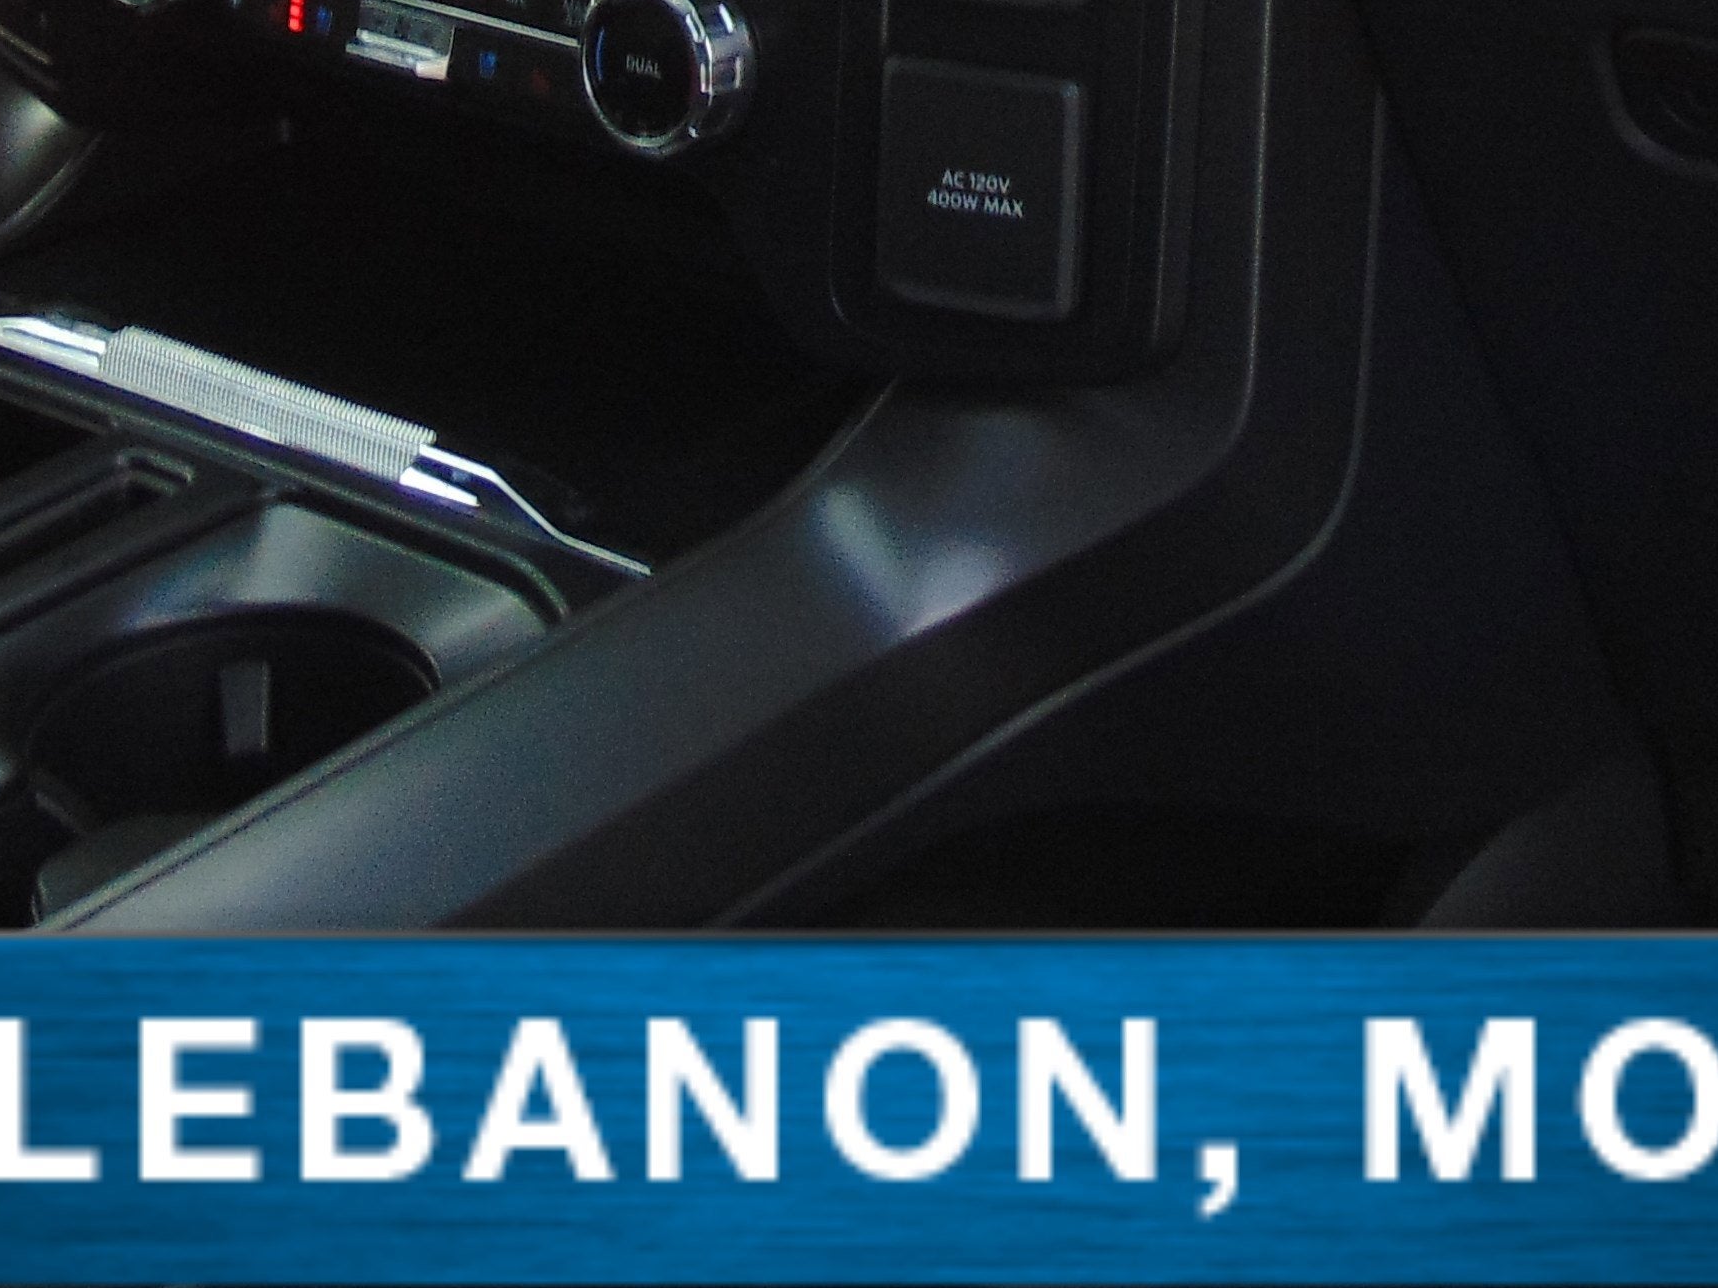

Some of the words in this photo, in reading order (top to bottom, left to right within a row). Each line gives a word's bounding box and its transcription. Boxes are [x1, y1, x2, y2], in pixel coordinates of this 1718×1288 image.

[625, 53, 663, 81] DUAL
[941, 168, 965, 190] AC
[969, 171, 1011, 194] 120V
[926, 189, 979, 212] 400W
[983, 195, 1025, 219] MAX
